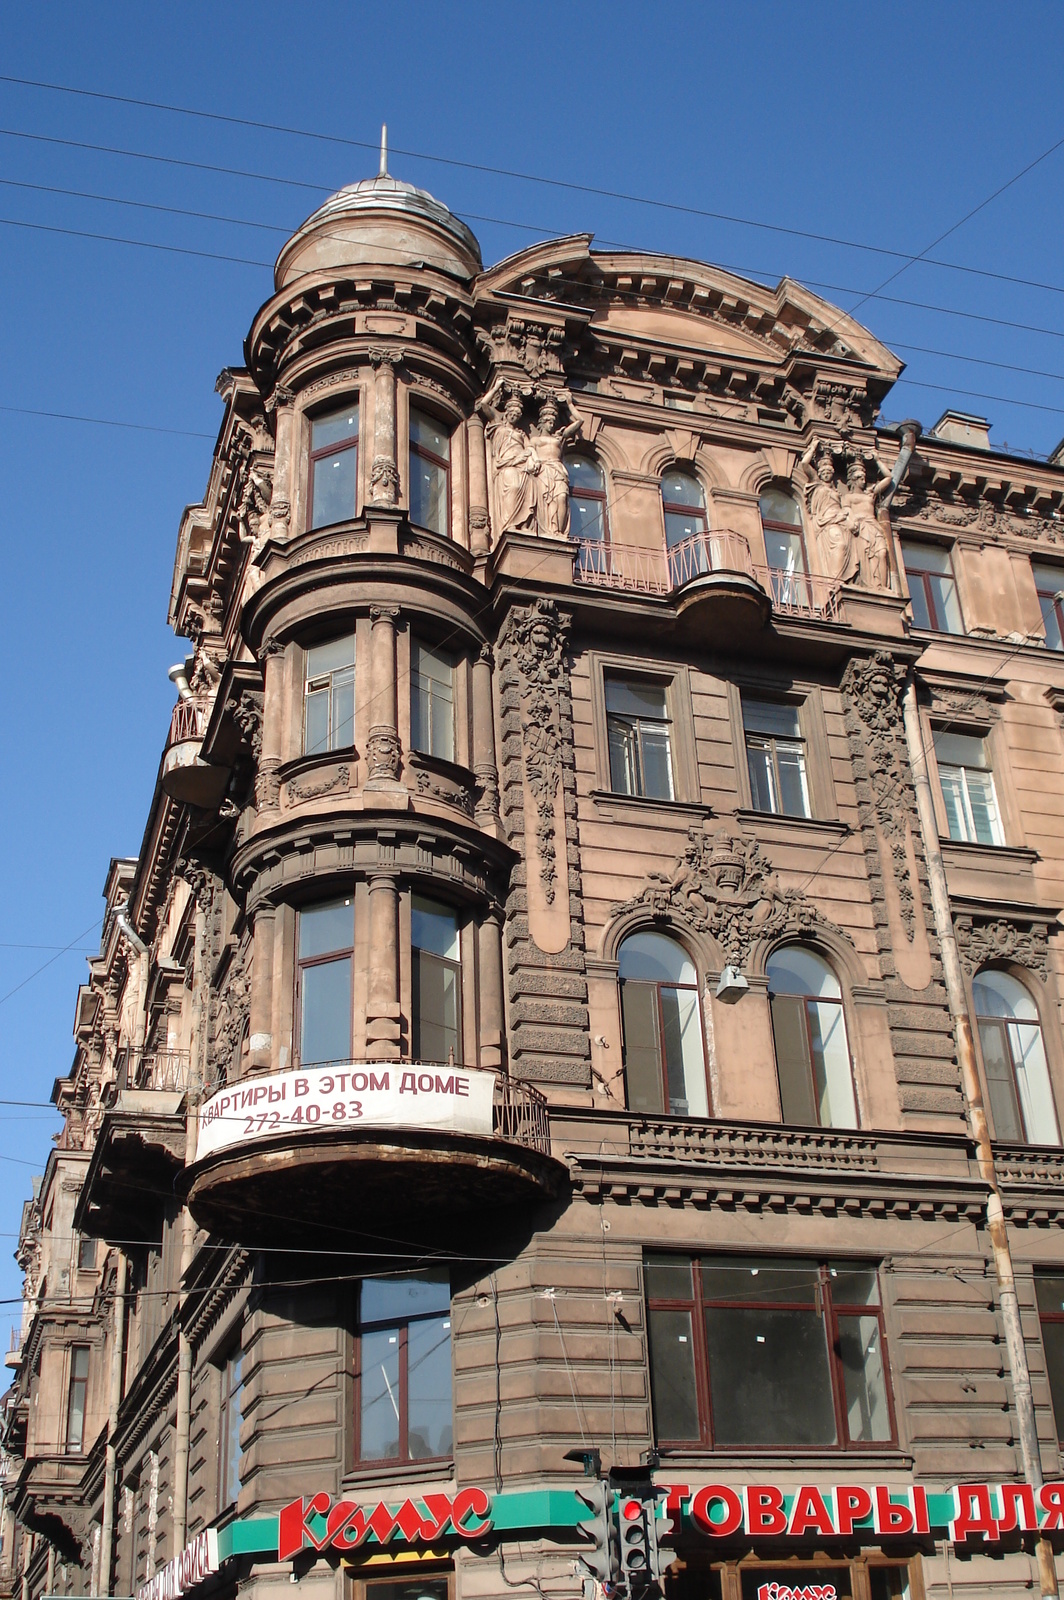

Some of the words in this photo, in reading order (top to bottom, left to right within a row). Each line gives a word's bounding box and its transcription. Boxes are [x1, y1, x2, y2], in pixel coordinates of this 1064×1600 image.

[201, 1081, 287, 1130] КВАРТИРЫ
[294, 1077, 309, 1098] В
[318, 1071, 390, 1095] ЭТОМ
[398, 1072, 470, 1097] ДОМЕ
[243, 1100, 363, 1135] 272-40-83
[652, 1484, 931, 1538] ТОВАРЫ
[947, 1482, 1064, 1541] ДЛЯ
